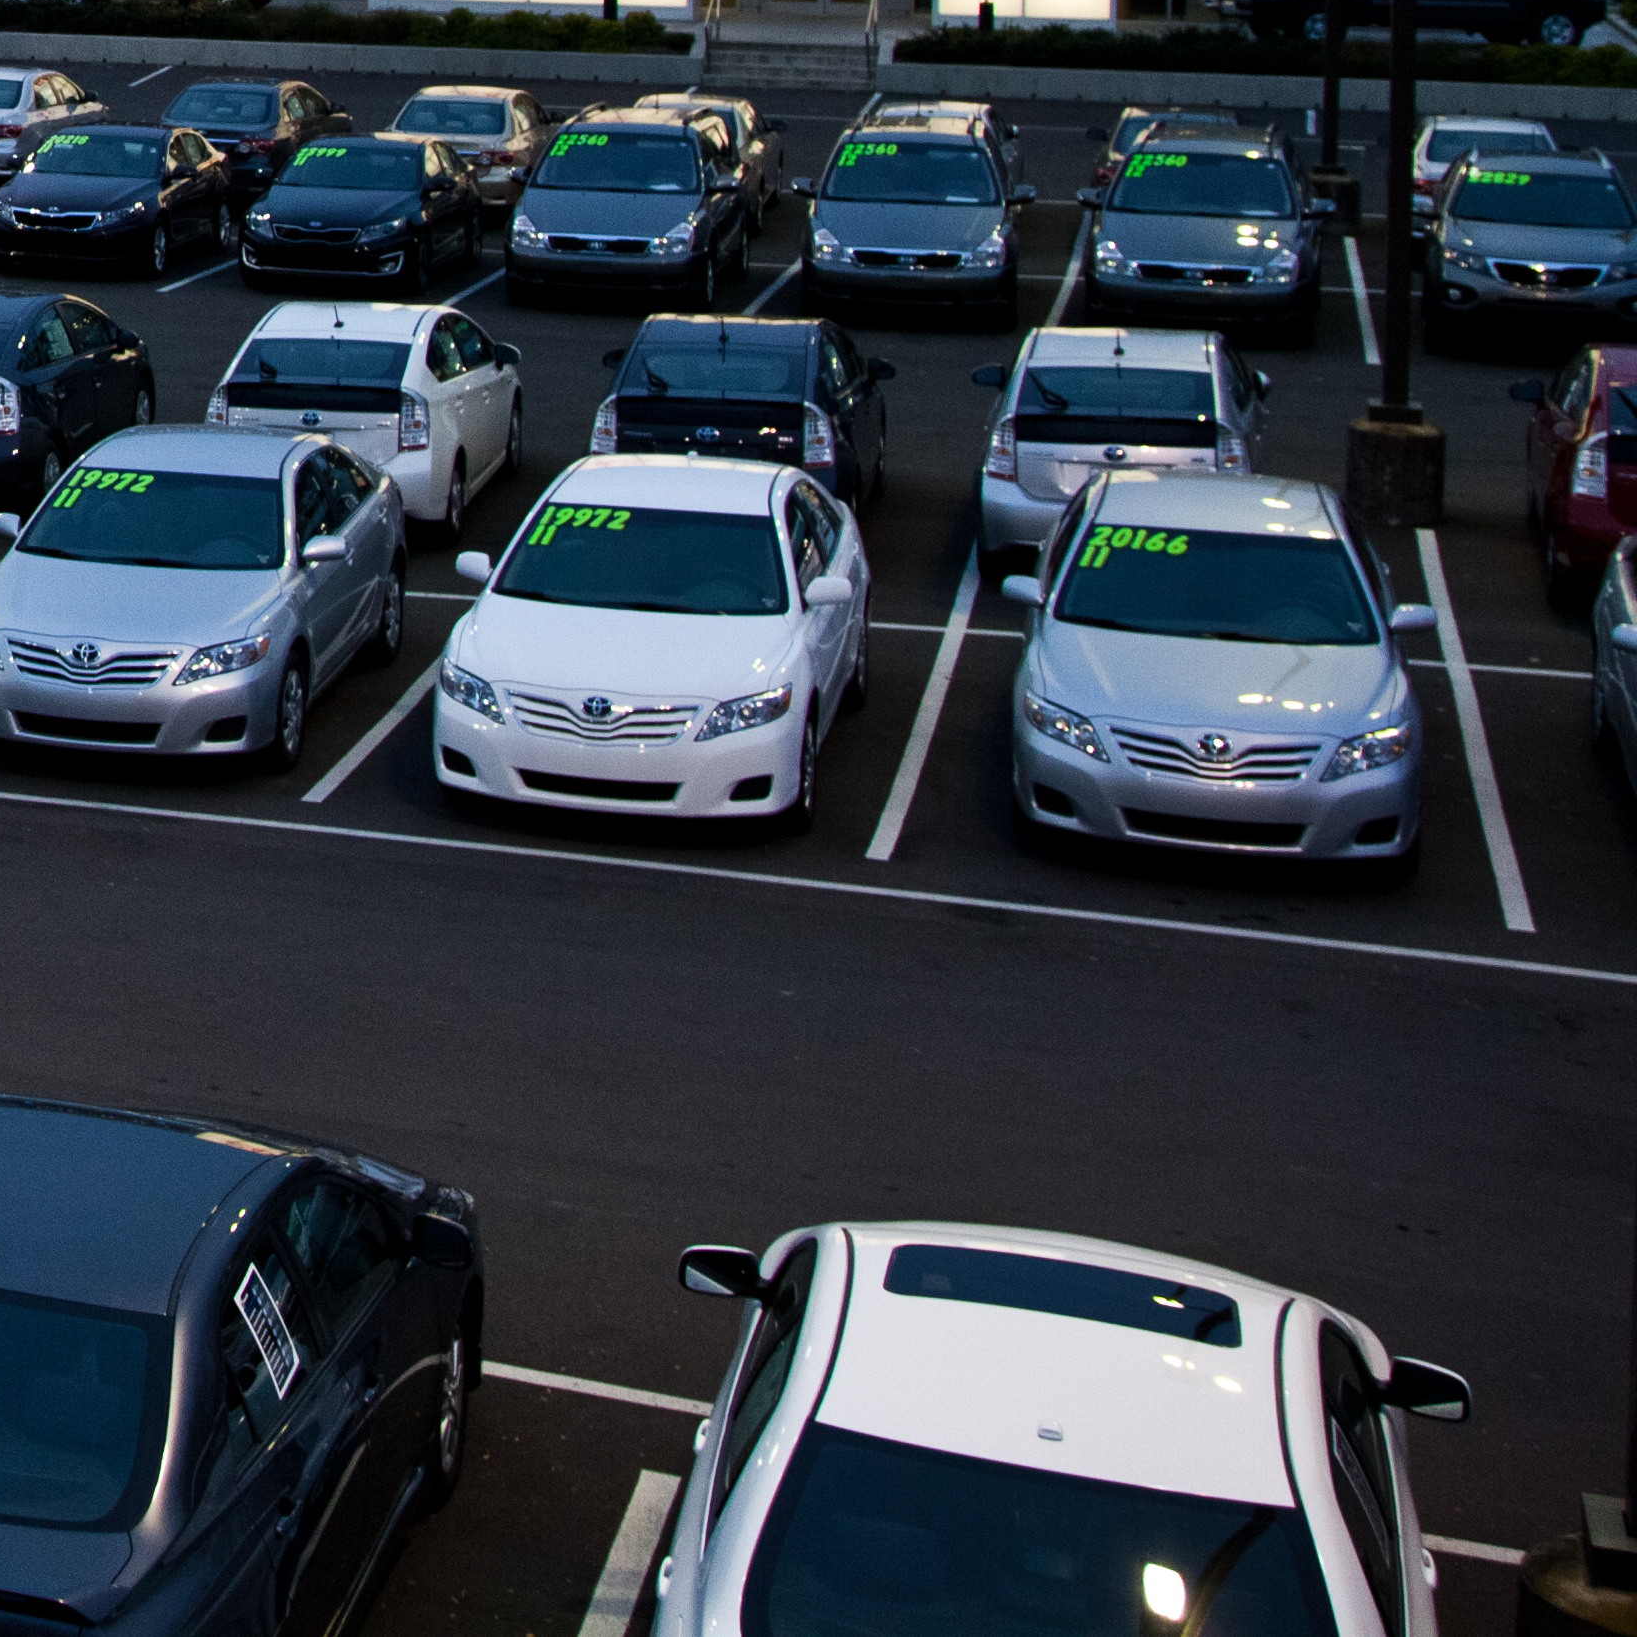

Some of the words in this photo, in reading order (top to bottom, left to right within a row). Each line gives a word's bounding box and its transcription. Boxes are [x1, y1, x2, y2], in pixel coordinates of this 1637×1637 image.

[558, 133, 609, 147] 22560
[844, 143, 898, 156] 22560
[1131, 153, 1188, 168] 22560
[67, 468, 155, 494] 19972
[52, 487, 83, 509] 11
[539, 505, 631, 531] 19972
[527, 524, 558, 546] 11
[1087, 525, 1189, 556] 20166
[1078, 544, 1111, 569] 11
